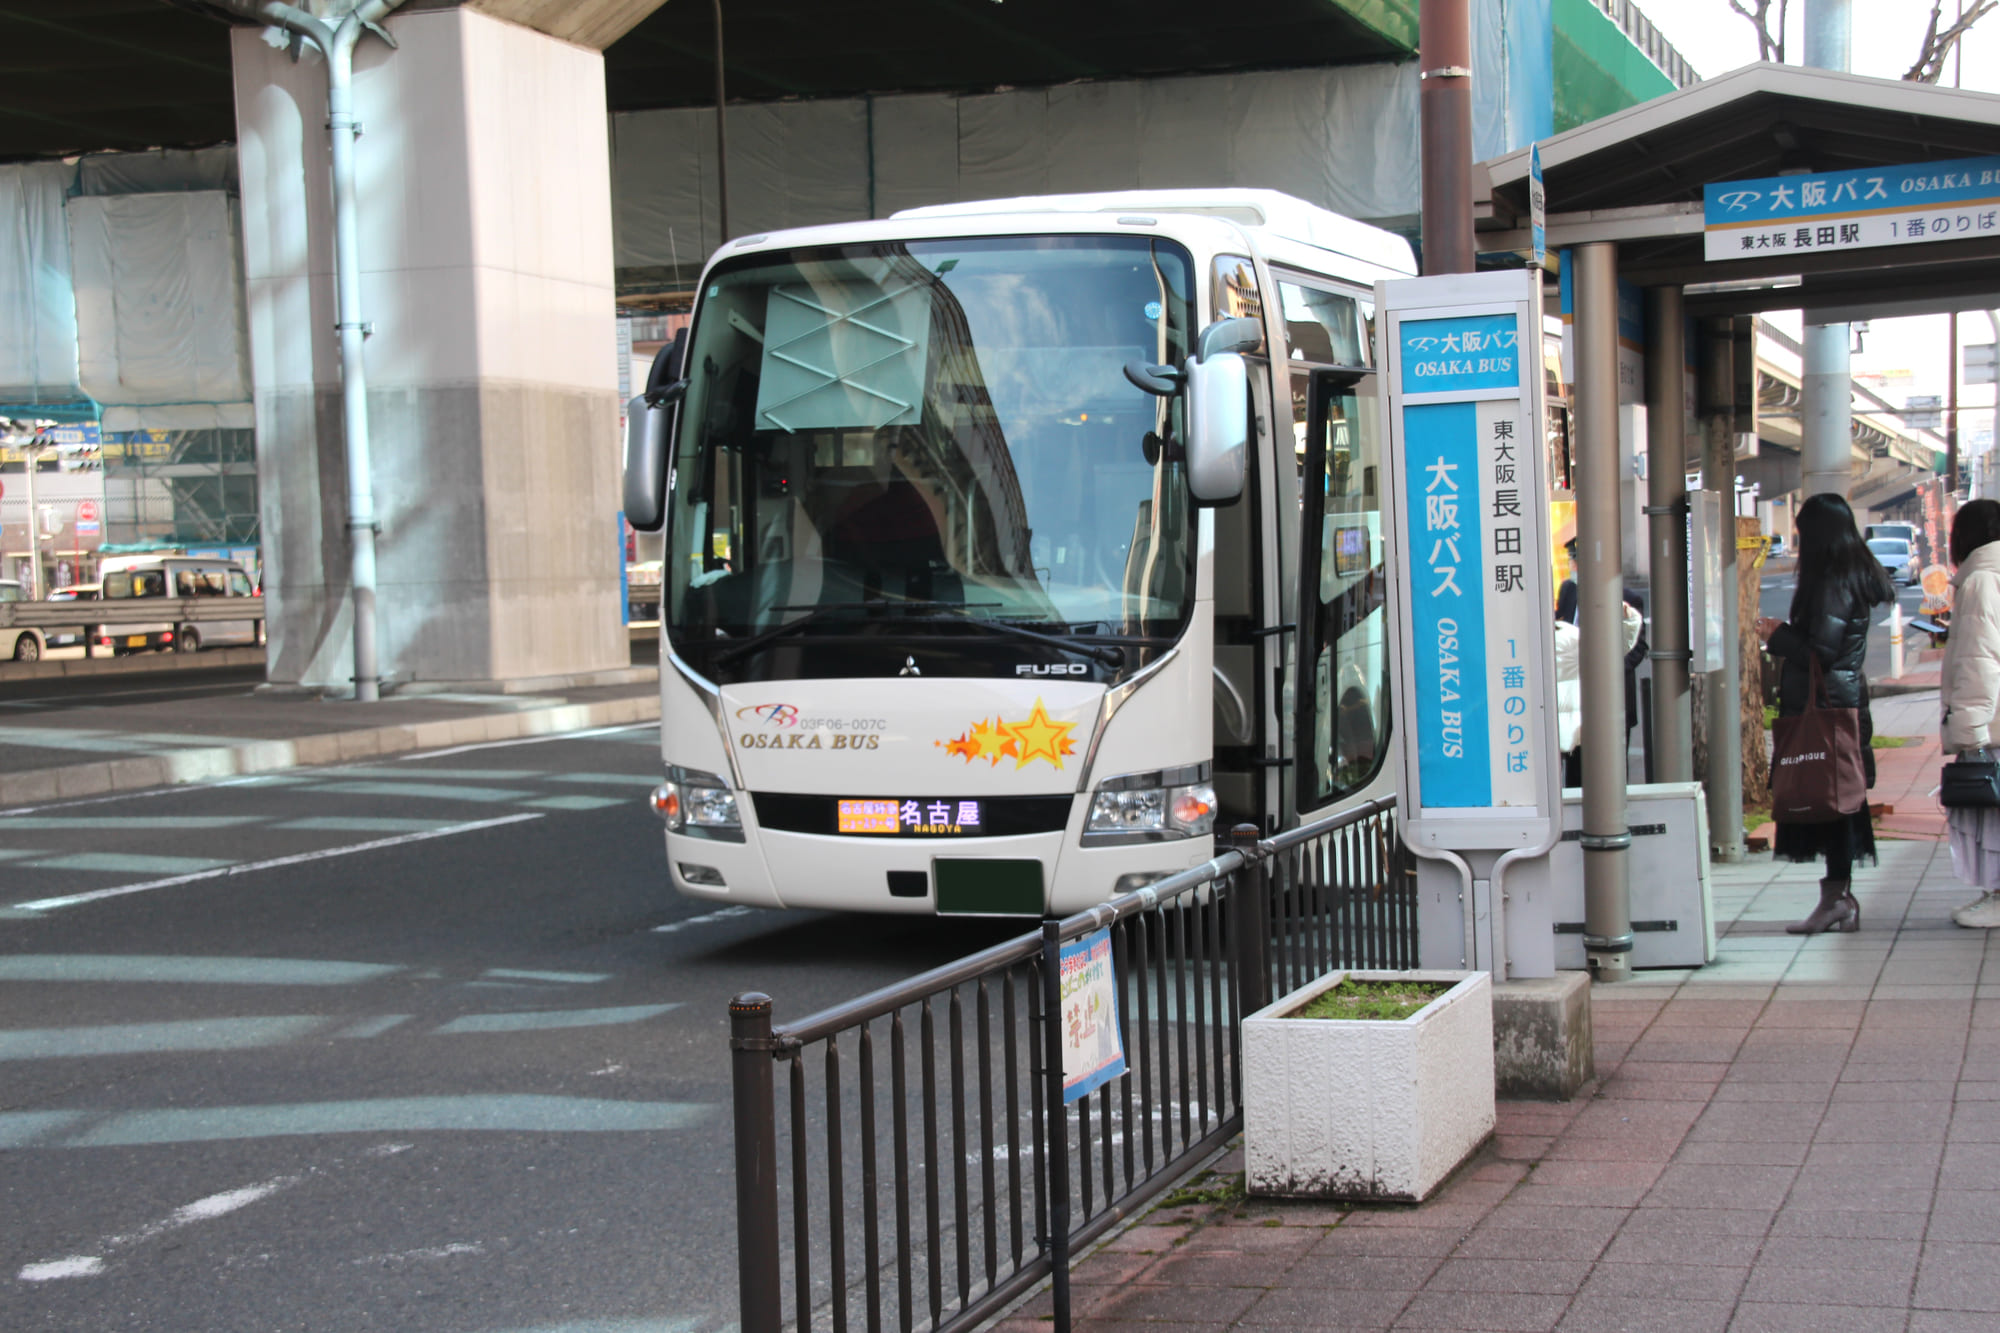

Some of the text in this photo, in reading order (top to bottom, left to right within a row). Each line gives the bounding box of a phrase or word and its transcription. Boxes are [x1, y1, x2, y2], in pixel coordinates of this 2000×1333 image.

[1769, 177, 1888, 211] 大阪バス
[1900, 172, 1972, 193] OSAKA
[1890, 212, 1997, 238] 1番のりば
[1441, 330, 1519, 354] 大阪バス
[1414, 357, 1512, 377] OSAKA BUS
[1425, 456, 1463, 597] 大阪バス
[1016, 664, 1087, 675] FUSO
[1437, 617, 1464, 759] OSAKA BUS
[1501, 639, 1529, 774] 1番のりば
[740, 733, 880, 750] OSAKA BUS
[900, 800, 980, 826] 名古屋
[914, 823, 962, 833] NAGOYA
